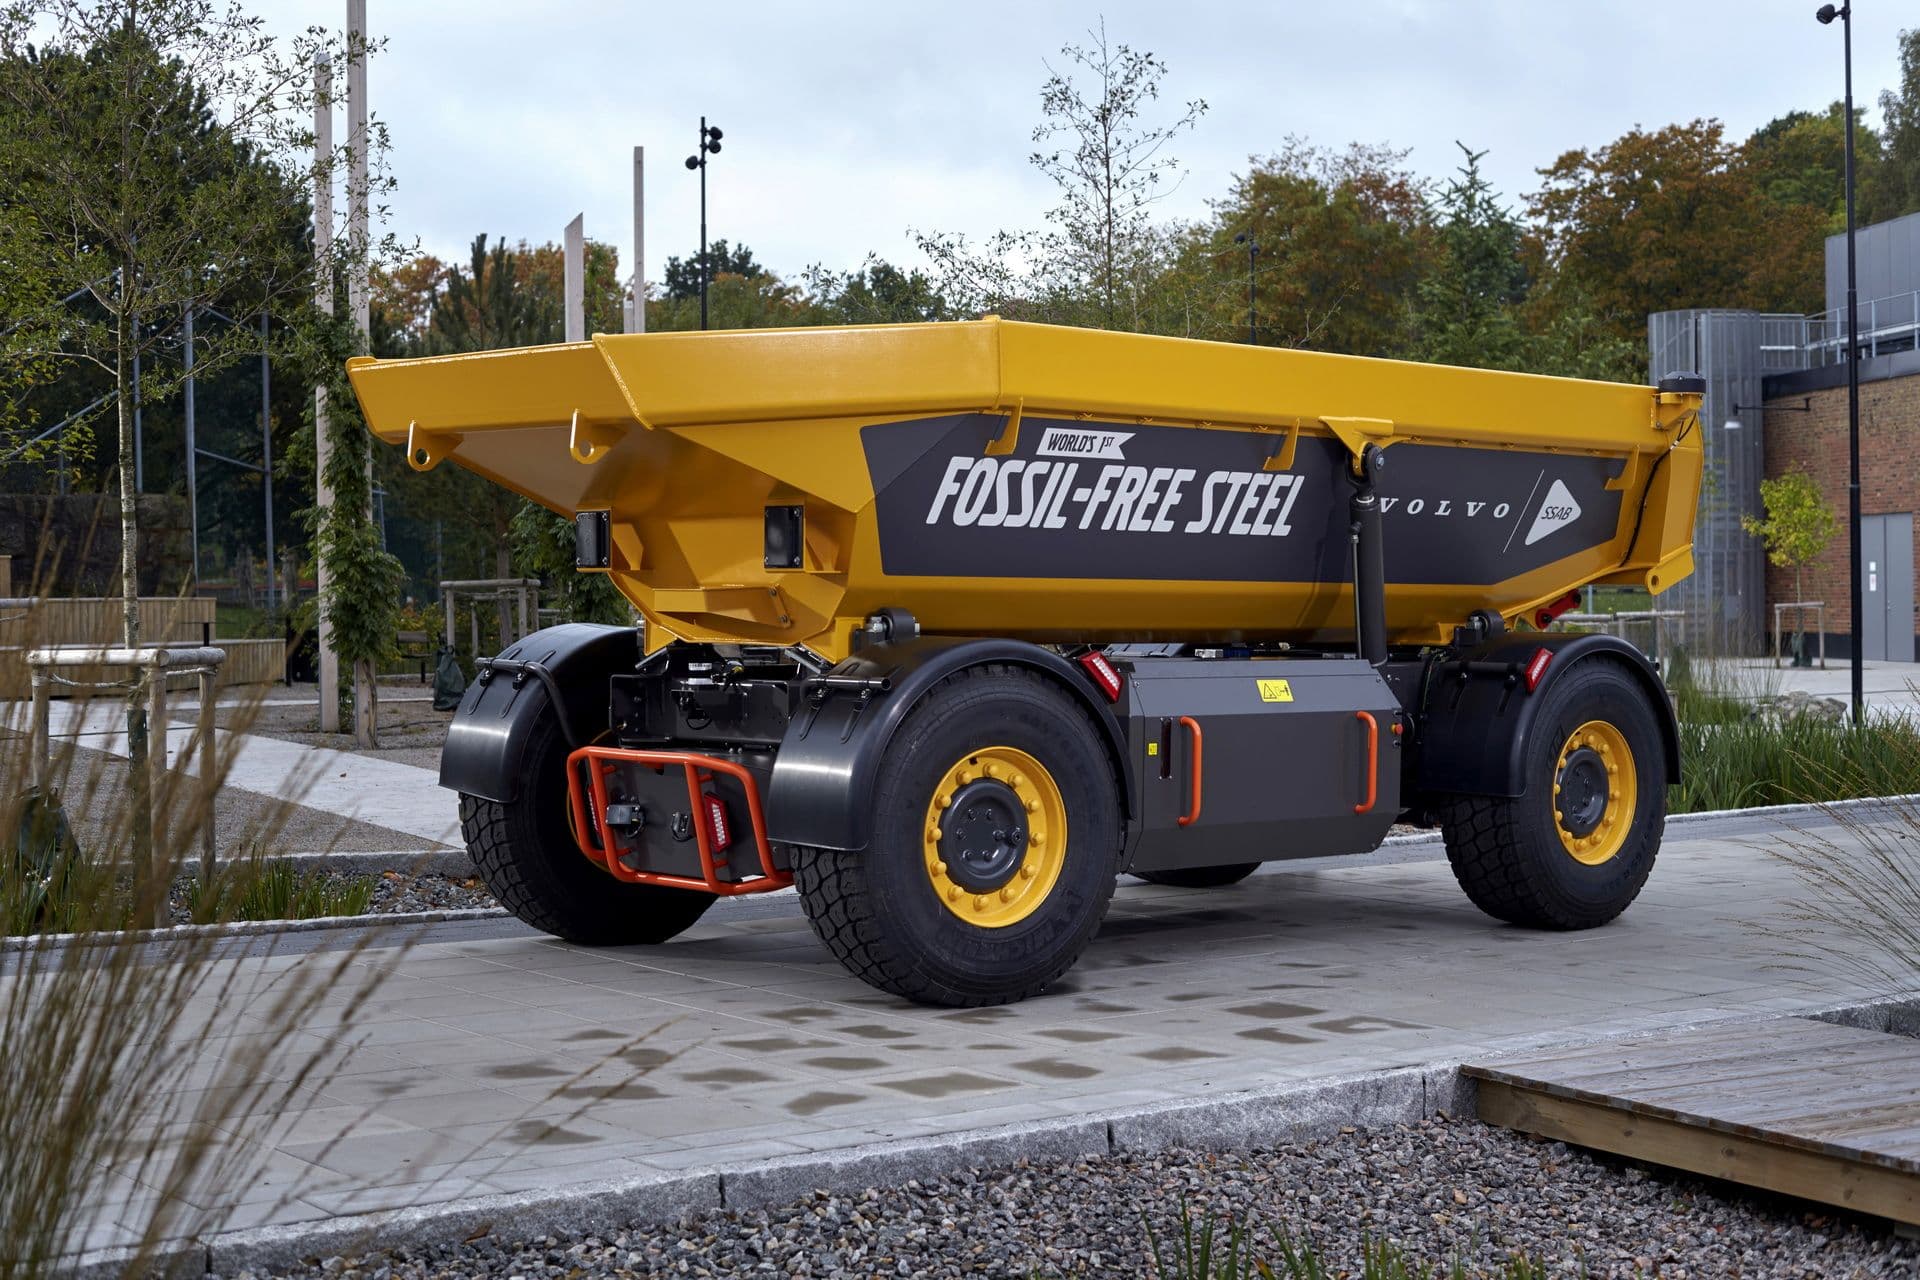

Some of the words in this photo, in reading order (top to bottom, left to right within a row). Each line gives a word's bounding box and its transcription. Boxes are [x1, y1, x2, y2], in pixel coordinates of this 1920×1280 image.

[1047, 433, 1097, 453] WORLD'S
[1098, 436, 1115, 453] 1ST
[926, 456, 1196, 533] FOSSIL-FREE
[1185, 471, 1304, 537] STEEL
[1380, 497, 1510, 519] VOLVO
[1541, 506, 1572, 520] SSAB
